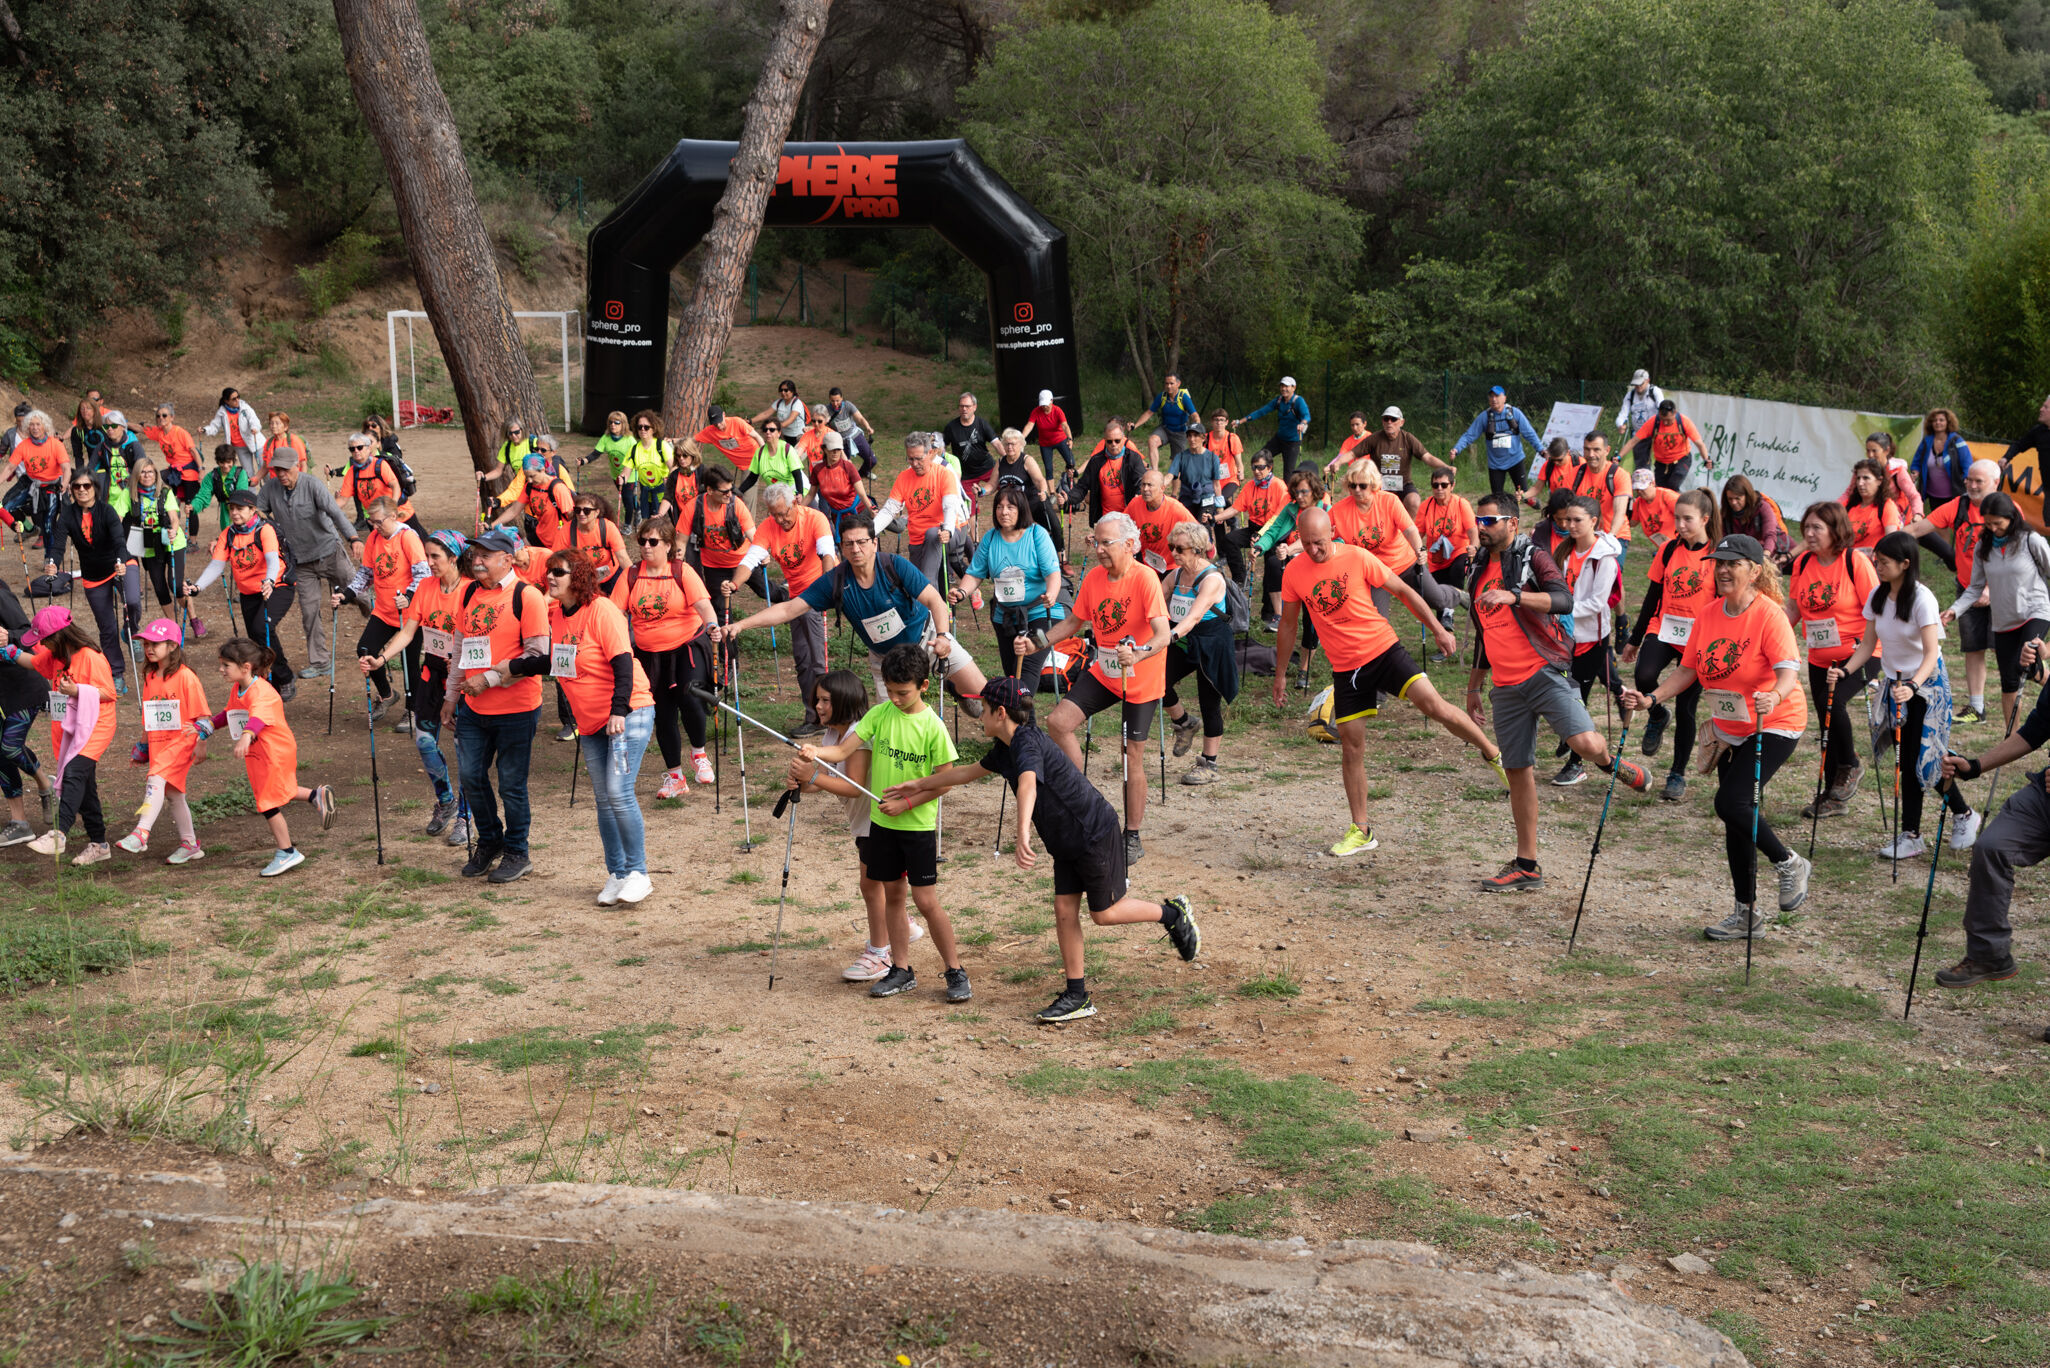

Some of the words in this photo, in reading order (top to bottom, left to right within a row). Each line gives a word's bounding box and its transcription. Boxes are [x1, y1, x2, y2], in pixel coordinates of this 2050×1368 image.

[771, 154, 899, 197] PHERE
[842, 196, 900, 218] PRO
[591, 320, 641, 333] sphere_pro
[1000, 323, 1053, 336] sphere_pro
[996, 338, 1065, 350] www.sphere-pro.com
[1745, 432, 1801, 454] Fundació
[1742, 460, 1769, 478] Roser
[1773, 466, 1785, 481] de
[1790, 473, 1821, 493] maig
[1003, 586, 1016, 597] 82
[1173, 605, 1187, 617] 100
[876, 621, 891, 635] 27
[1672, 625, 1687, 638] 35
[1812, 629, 1830, 641] 167
[432, 638, 445, 650] 93
[468, 648, 485, 660] 133
[556, 656, 570, 668] 124
[53, 702, 67, 713] 128
[1718, 700, 1736, 713] 28
[154, 711, 173, 722] 129
